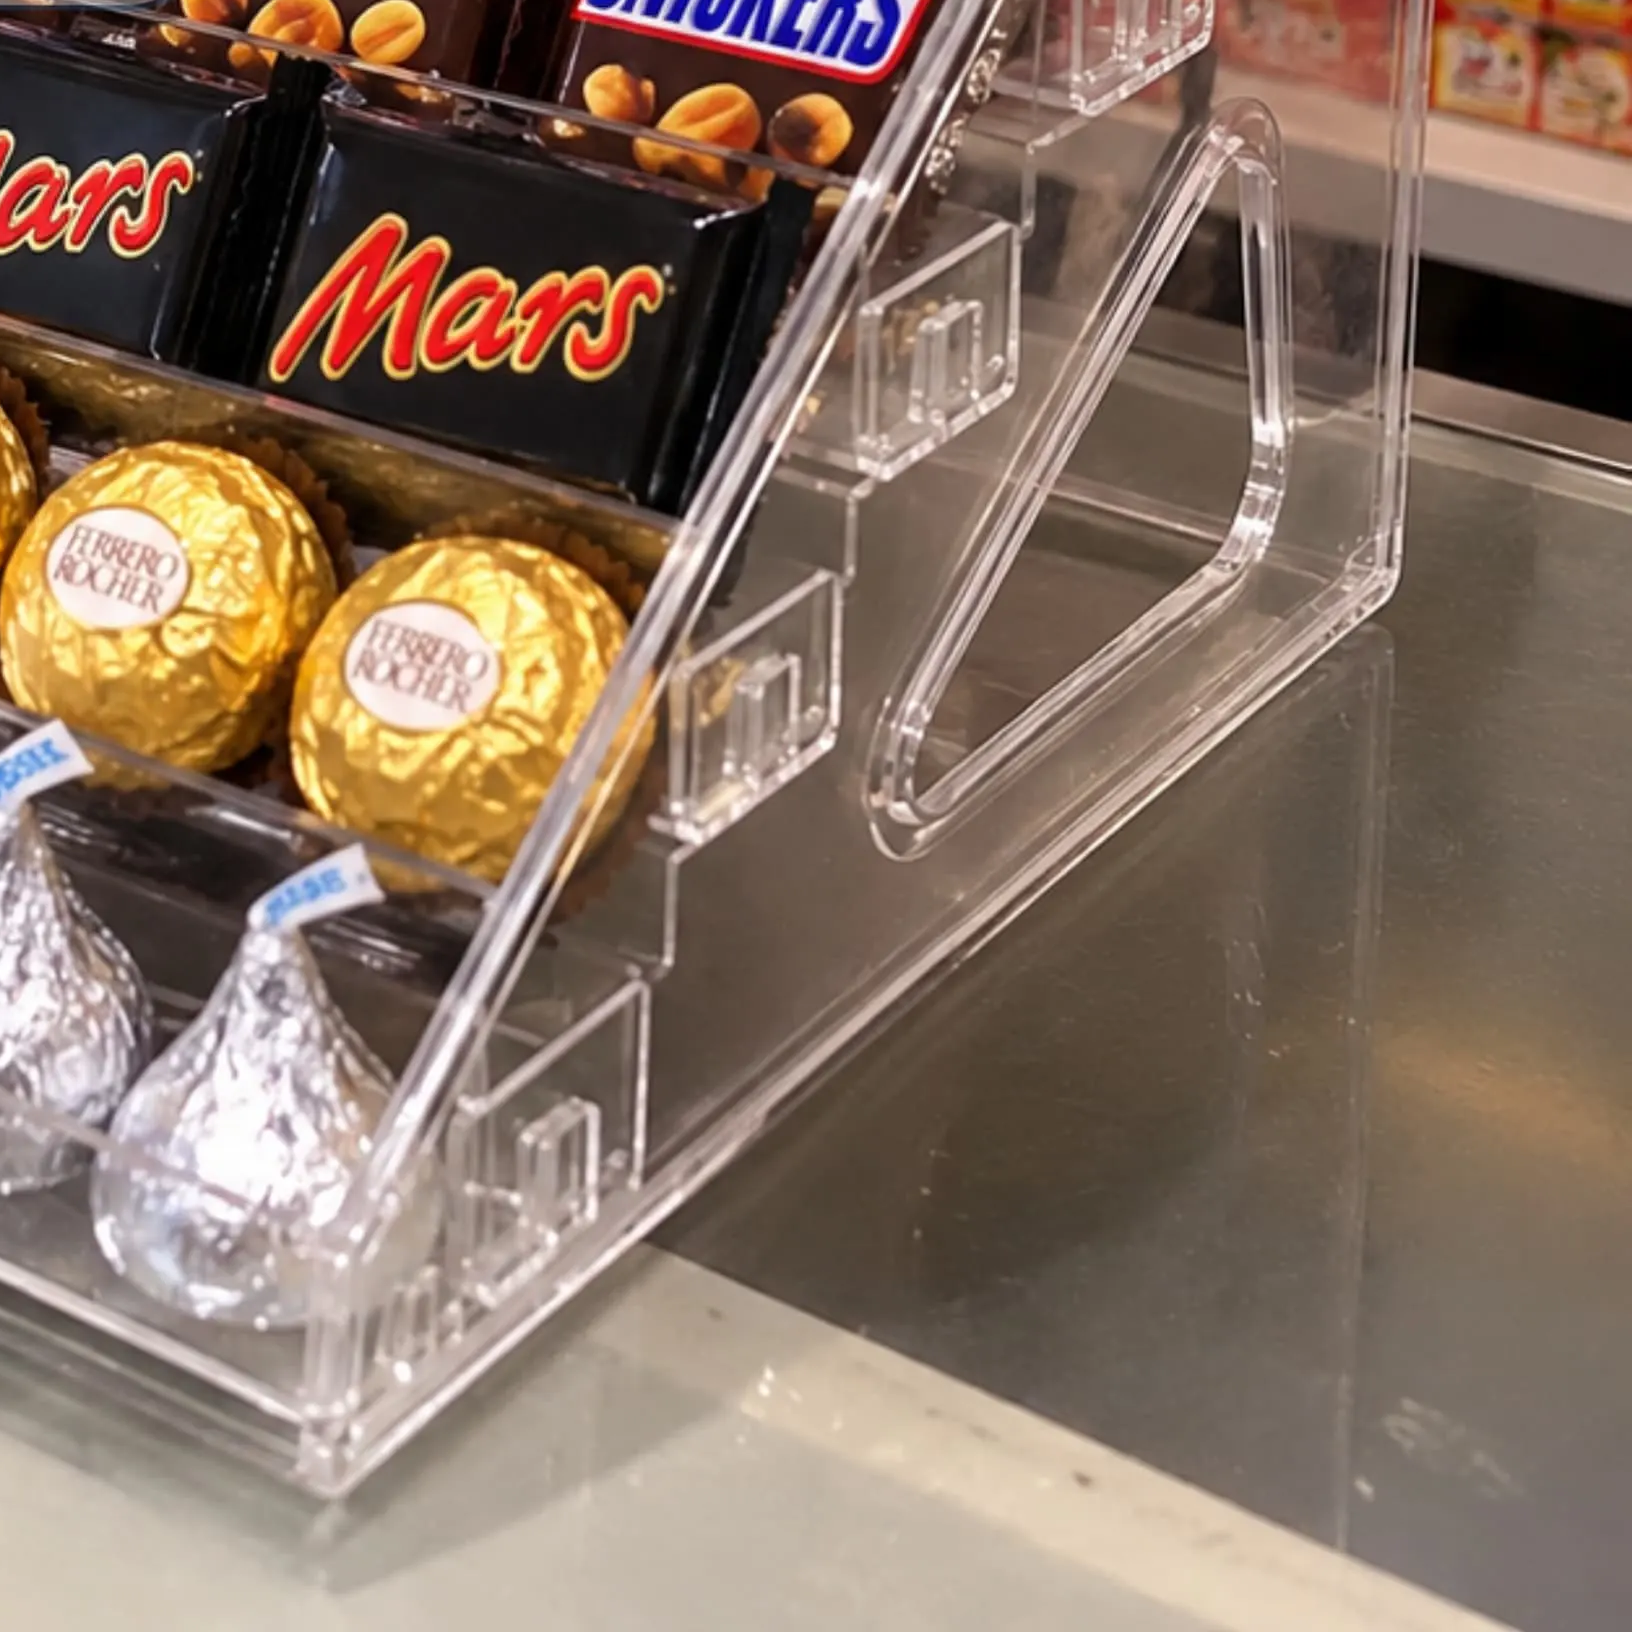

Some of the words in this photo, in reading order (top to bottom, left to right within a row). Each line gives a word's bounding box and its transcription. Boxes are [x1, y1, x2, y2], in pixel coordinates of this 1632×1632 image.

[270, 213, 664, 384] Mars
[67, 523, 179, 581] FERRERO
[53, 553, 164, 614] ROCHER
[368, 618, 489, 682] FERRERO
